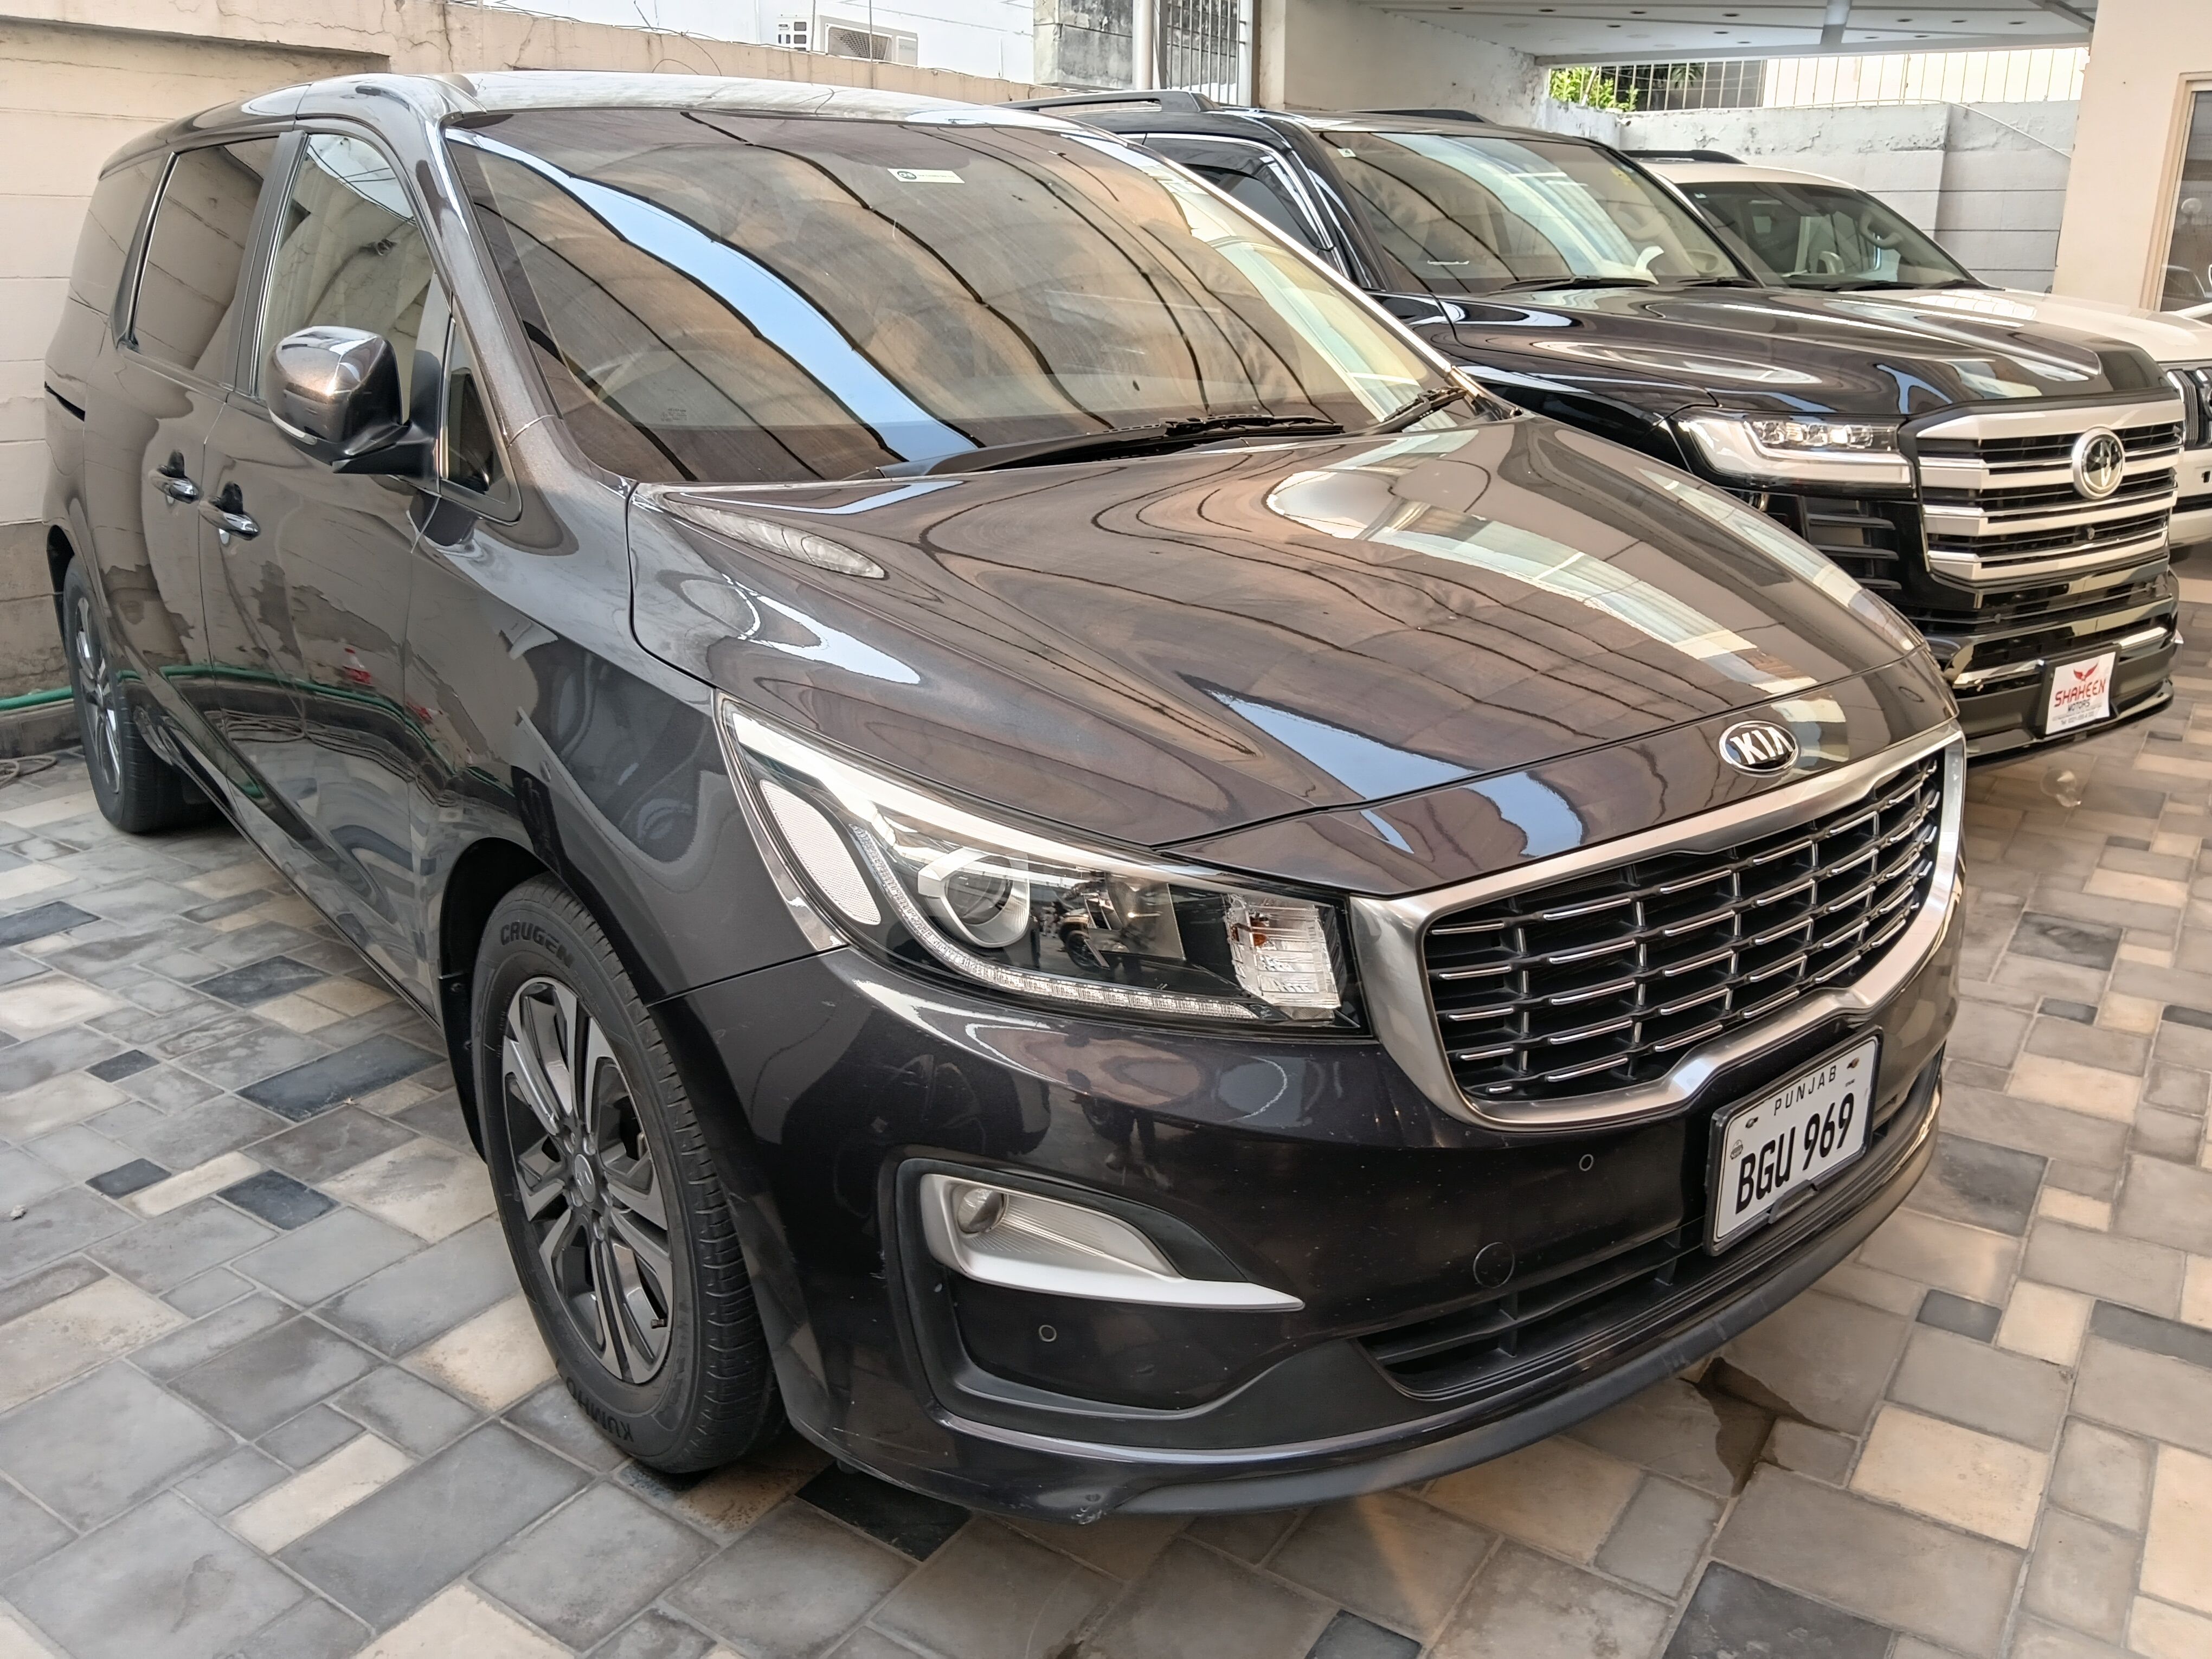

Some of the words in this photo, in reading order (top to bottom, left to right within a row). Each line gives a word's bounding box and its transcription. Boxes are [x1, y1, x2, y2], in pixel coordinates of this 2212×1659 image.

[2054, 679, 2106, 708] SHAHEEN
[1729, 726, 1793, 765] KIA
[1773, 1065, 1837, 1116] PUNJAB
[1735, 1126, 1795, 1214] BGU
[1802, 1092, 1854, 1171] 969
